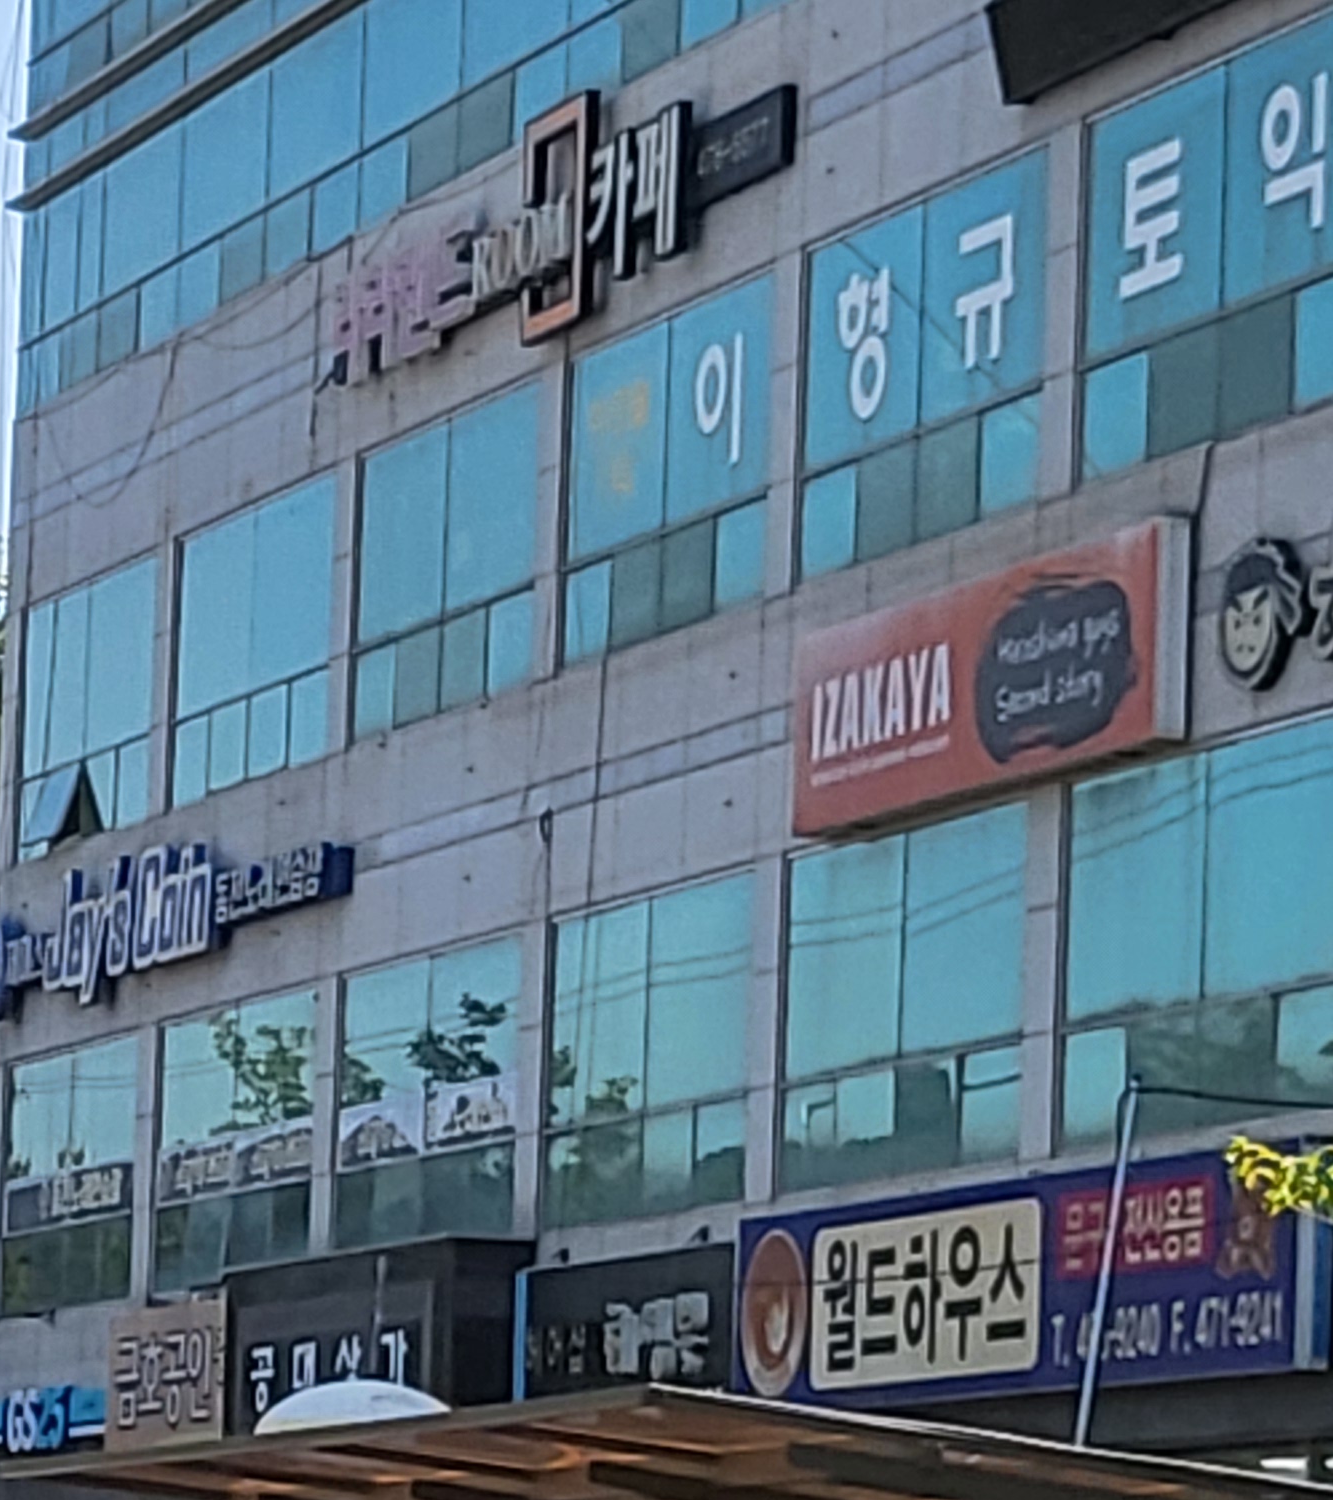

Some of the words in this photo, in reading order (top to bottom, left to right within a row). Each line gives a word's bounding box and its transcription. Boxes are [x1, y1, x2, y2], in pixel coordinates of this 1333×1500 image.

[584, 102, 682, 278] 카페
[1119, 70, 1329, 300] 토익
[810, 641, 950, 763] IZAKAYA
[823, 1223, 1027, 1374] 월드하우스
[6, 1386, 66, 1454] GS25
[113, 1325, 225, 1427] 금호공인
